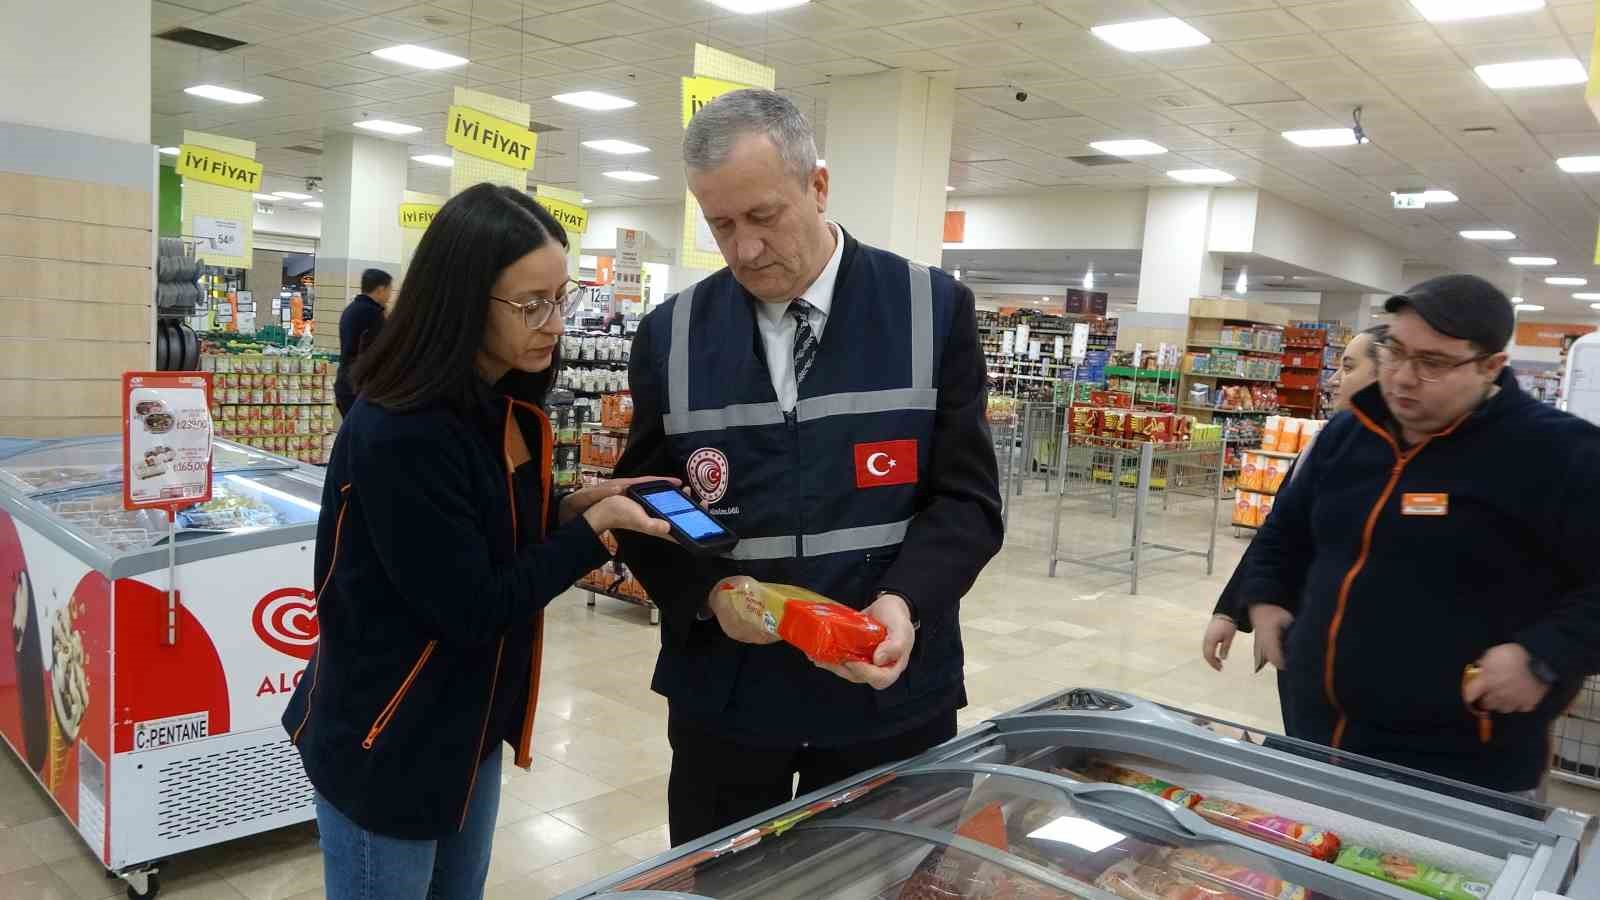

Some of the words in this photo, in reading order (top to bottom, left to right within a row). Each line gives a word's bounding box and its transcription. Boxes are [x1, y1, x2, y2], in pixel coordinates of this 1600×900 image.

[454, 113, 480, 141] İYİ
[482, 129, 531, 161] FİYAT
[185, 151, 209, 172] İYİ
[211, 161, 257, 184] FİYAT
[418, 211, 434, 222] FİY
[553, 208, 584, 228] FİYAT
[136, 720, 207, 749] C-PENTANE
